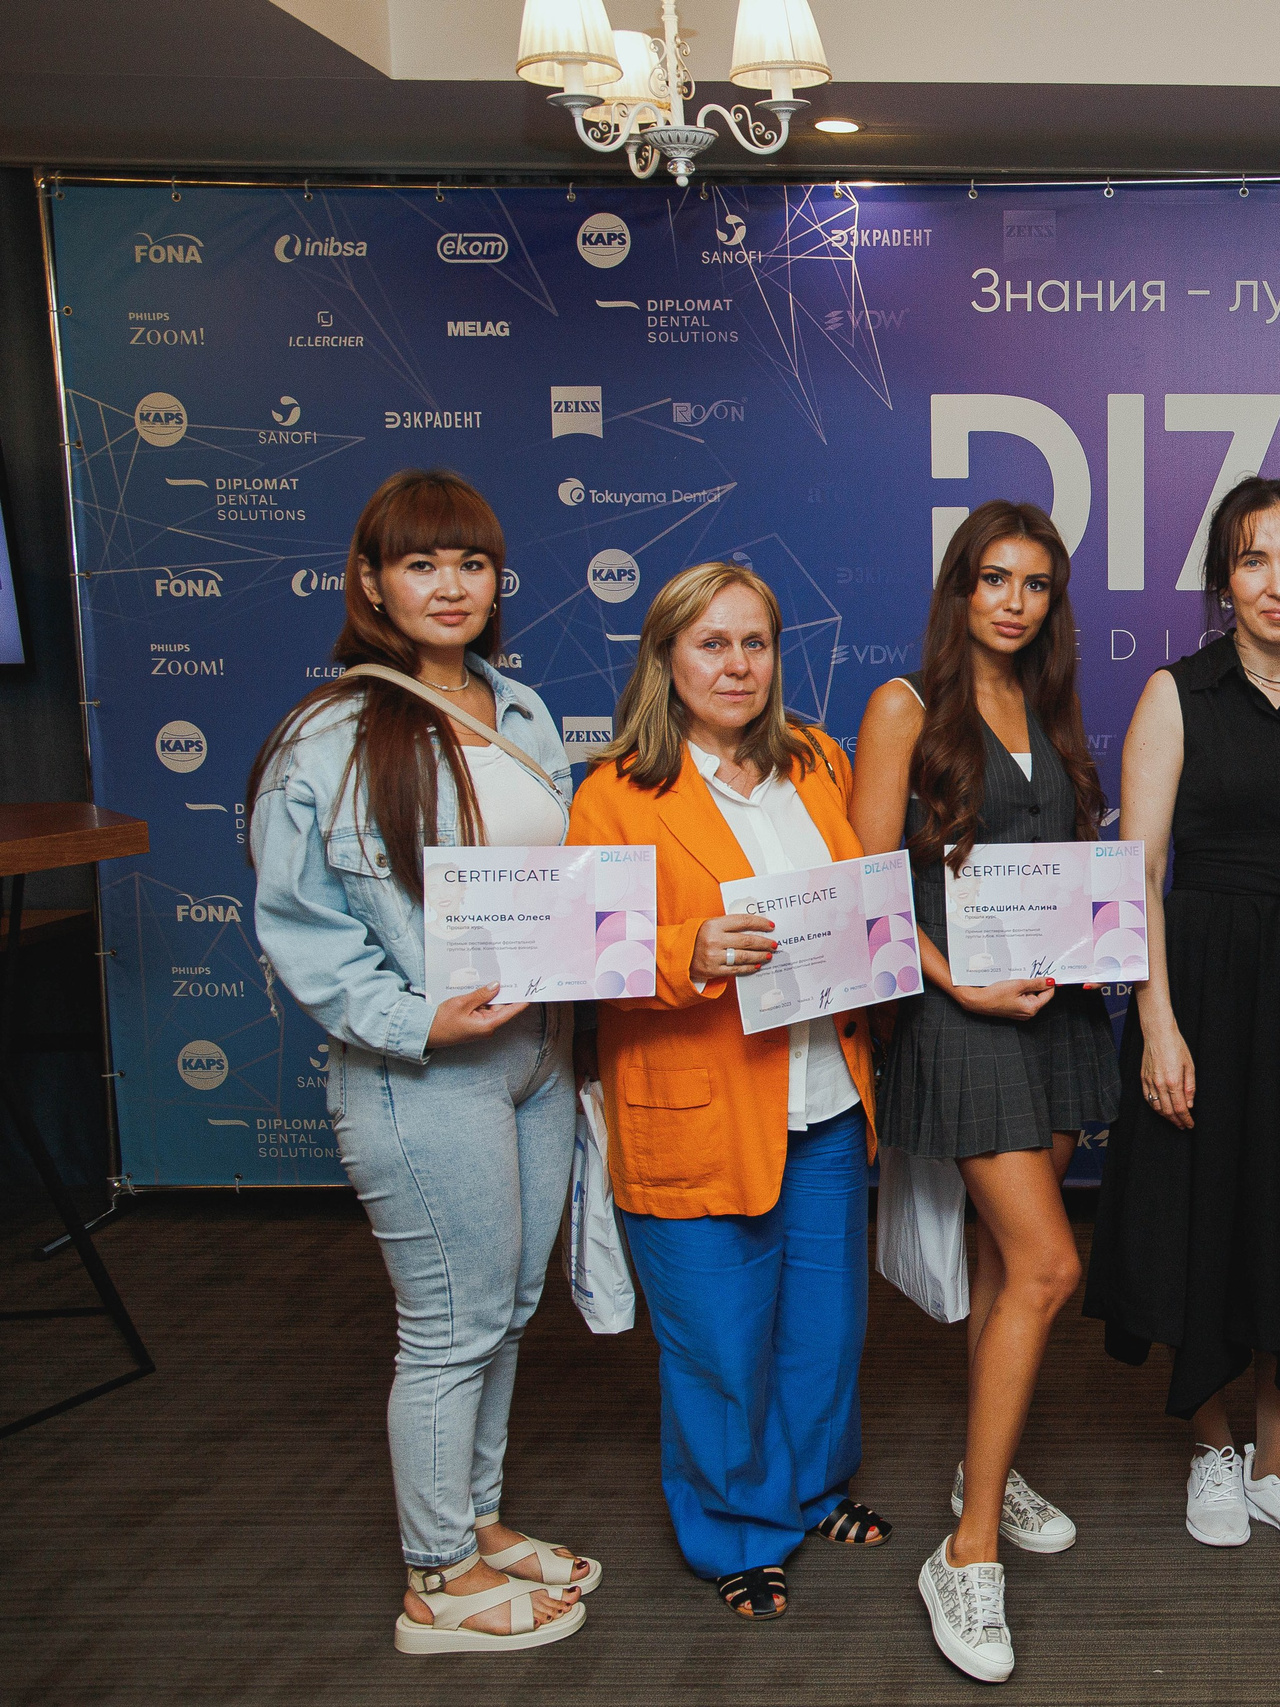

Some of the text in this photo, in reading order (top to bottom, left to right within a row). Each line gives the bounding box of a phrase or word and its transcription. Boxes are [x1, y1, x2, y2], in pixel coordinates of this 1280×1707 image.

[581, 231, 627, 248] KAPS
[849, 228, 932, 248] ЭКРАДЕНТ
[304, 237, 368, 258] inibsa
[442, 235, 503, 257] ekom
[134, 245, 203, 264] FONA
[701, 250, 763, 265] SANOFI
[971, 268, 1167, 313] Знания
[647, 299, 733, 313] DIPLOMAT
[129, 311, 170, 322] PHILIPS
[647, 316, 711, 328] DENTAL
[447, 320, 511, 337] MELAG
[288, 336, 365, 348] I.C.LERCHER
[647, 330, 739, 343] SOLUTIONS
[553, 400, 601, 413] ZEISS
[138, 411, 185, 426] KAPS
[403, 411, 482, 429] ЭКРАДЕНТ
[258, 431, 318, 445] SANOFI
[215, 478, 300, 491] DIPLOMAT
[216, 494, 278, 506] DENTAL
[589, 485, 721, 507] Tokuyama Dental
[217, 509, 306, 522] SOLUTIONS
[321, 573, 347, 591] ini
[592, 568, 637, 582] KAPS
[155, 579, 222, 597] FONA
[150, 643, 191, 653] PHILIPS
[852, 645, 909, 665] VDW
[565, 730, 611, 743] ZEISS
[160, 739, 204, 753] KAPS
[599, 850, 650, 863] DIZANE
[1095, 846, 1139, 858] DIZANE
[864, 858, 903, 875] DIZANE
[962, 863, 1061, 878] CERTIFICATE
[444, 868, 560, 883] CERTIFICATE
[746, 887, 838, 916] CERTIFICATE
[964, 904, 1058, 913] СТЕФАШИНА Алина
[176, 904, 242, 922] FONA
[445, 913, 551, 923] ЯКУЧАКОВА Олеся
[777, 930, 832, 947] АЧЕВА Елена
[171, 966, 211, 975] PHILIPS
[182, 1058, 225, 1072] KAPS
[297, 1076, 328, 1089] SAN
[257, 1133, 318, 1144] DENTAL
